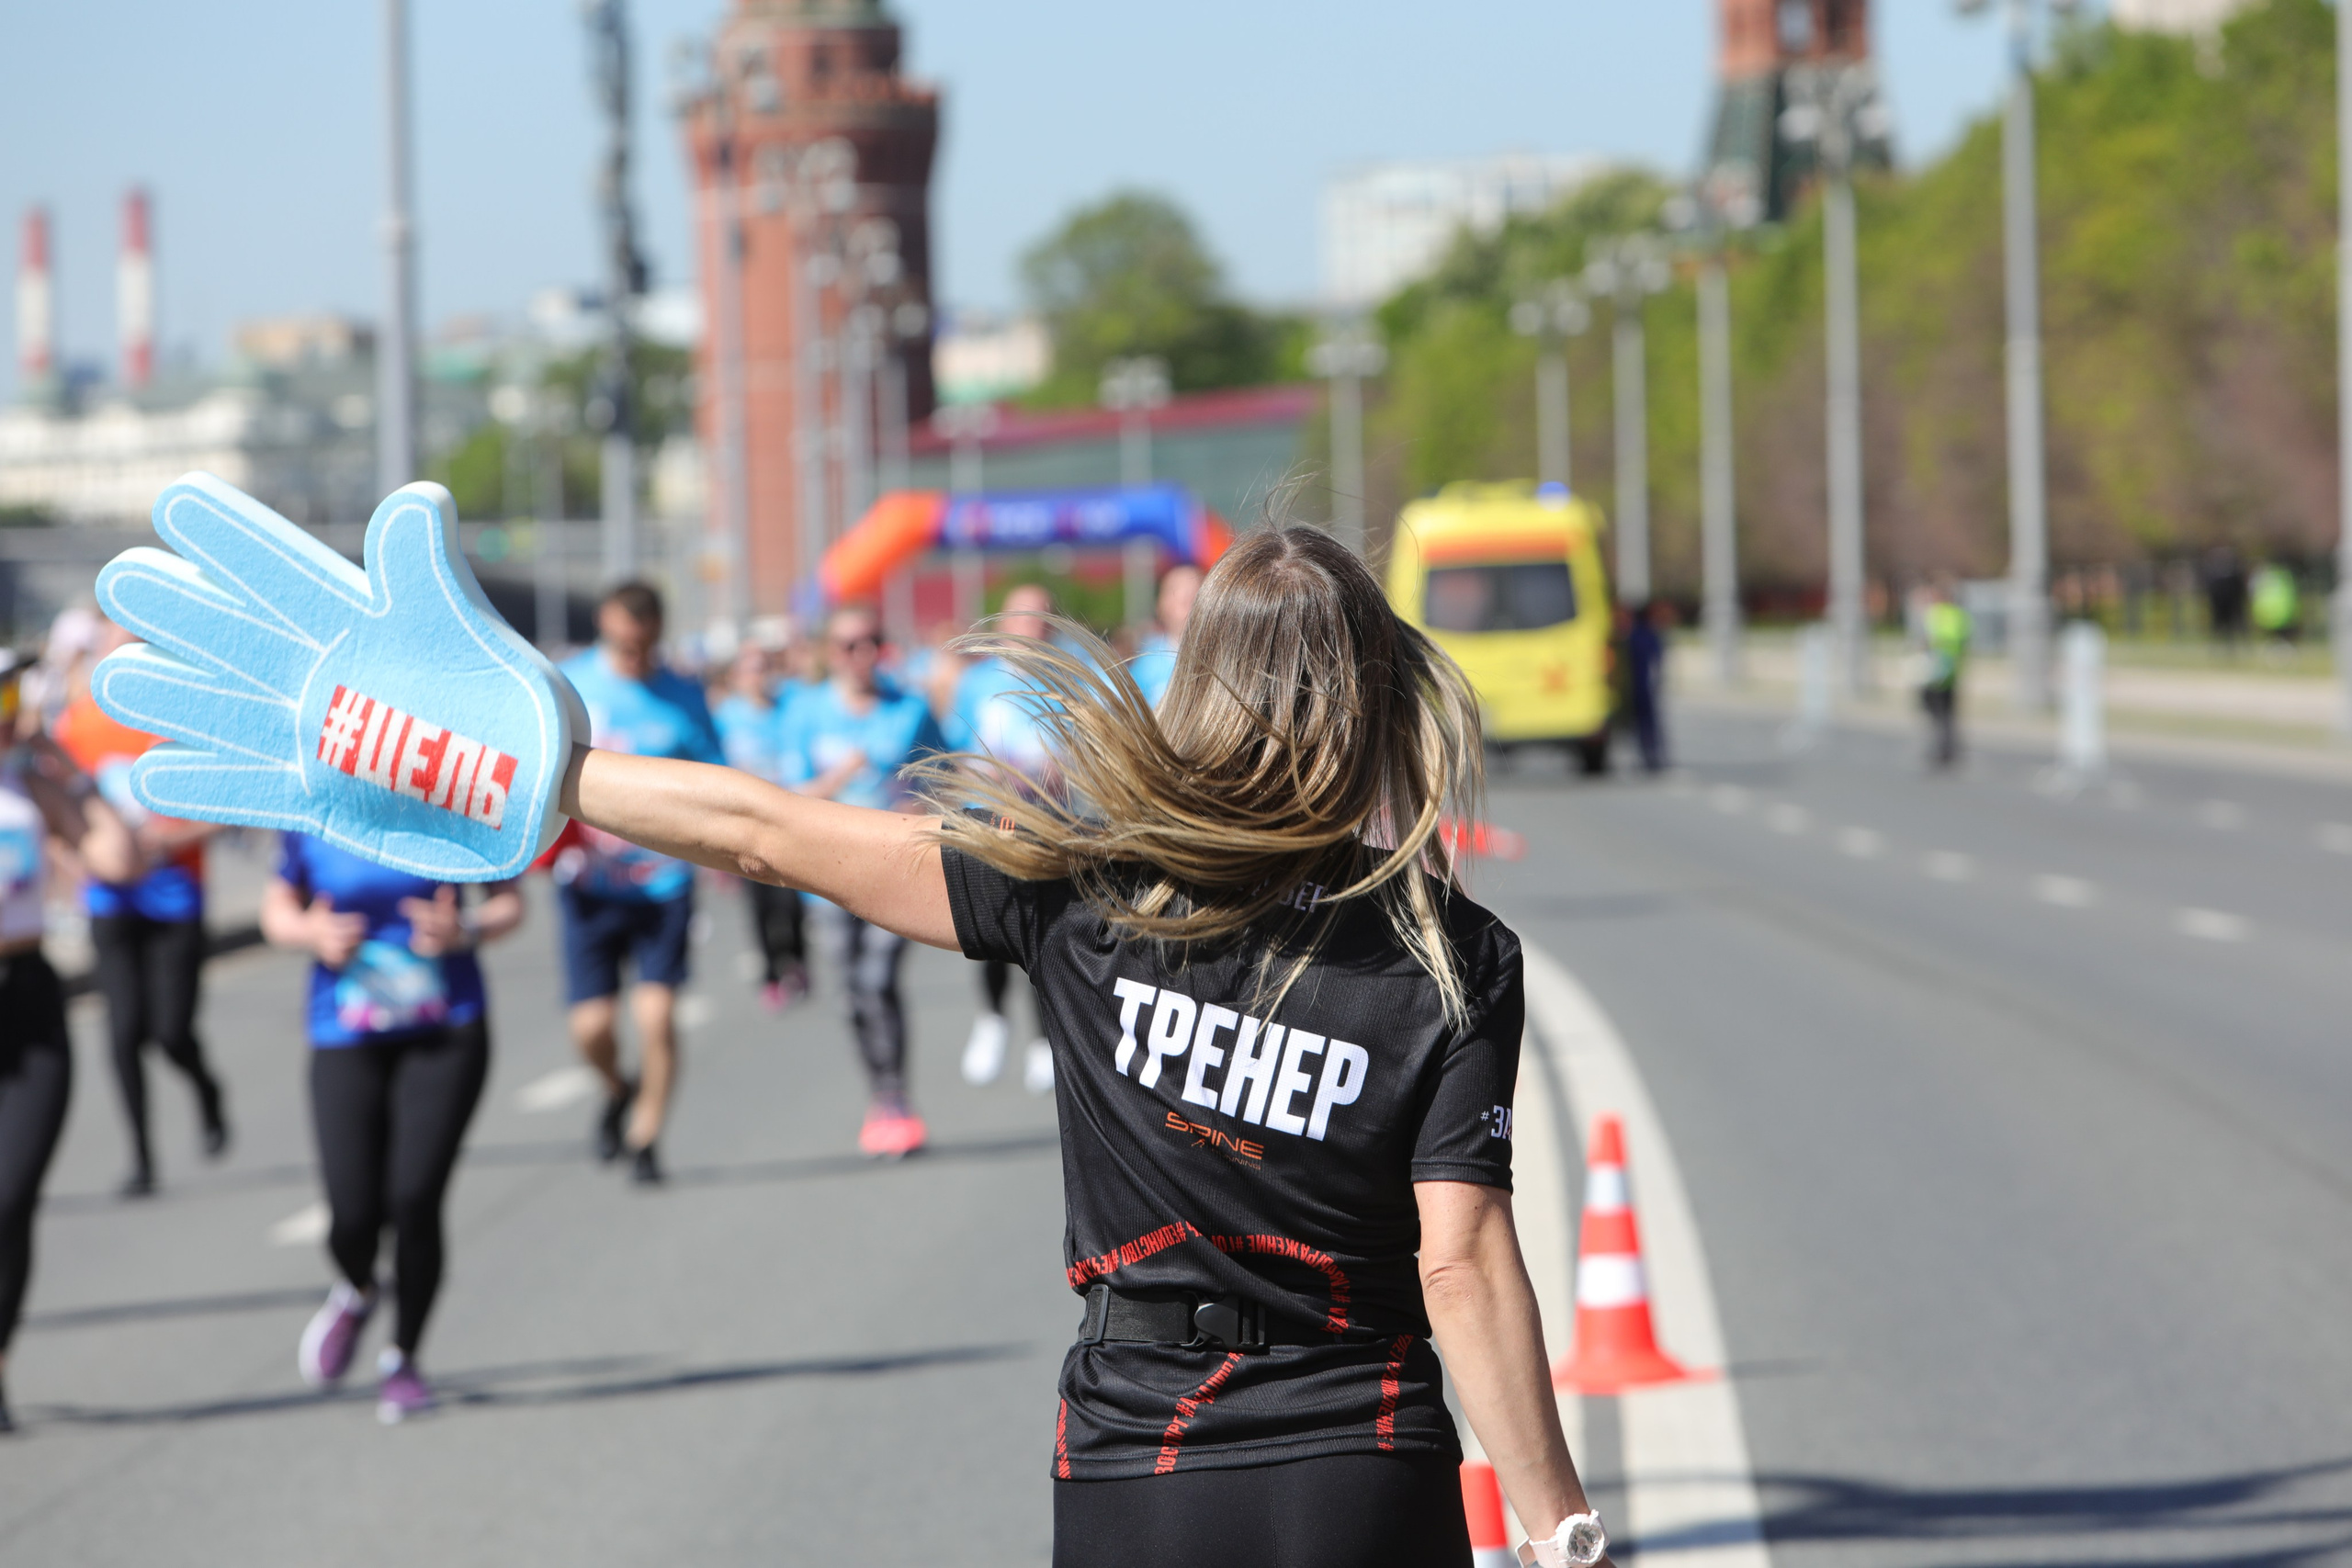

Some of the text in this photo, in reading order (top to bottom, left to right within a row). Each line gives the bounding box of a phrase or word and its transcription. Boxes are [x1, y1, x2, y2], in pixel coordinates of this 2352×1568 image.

[319, 685, 511, 829] #ЦЕЛЬ
[1113, 976, 1369, 1142] ТРЕНЕР
[1165, 1111, 1264, 1160] SPINE
